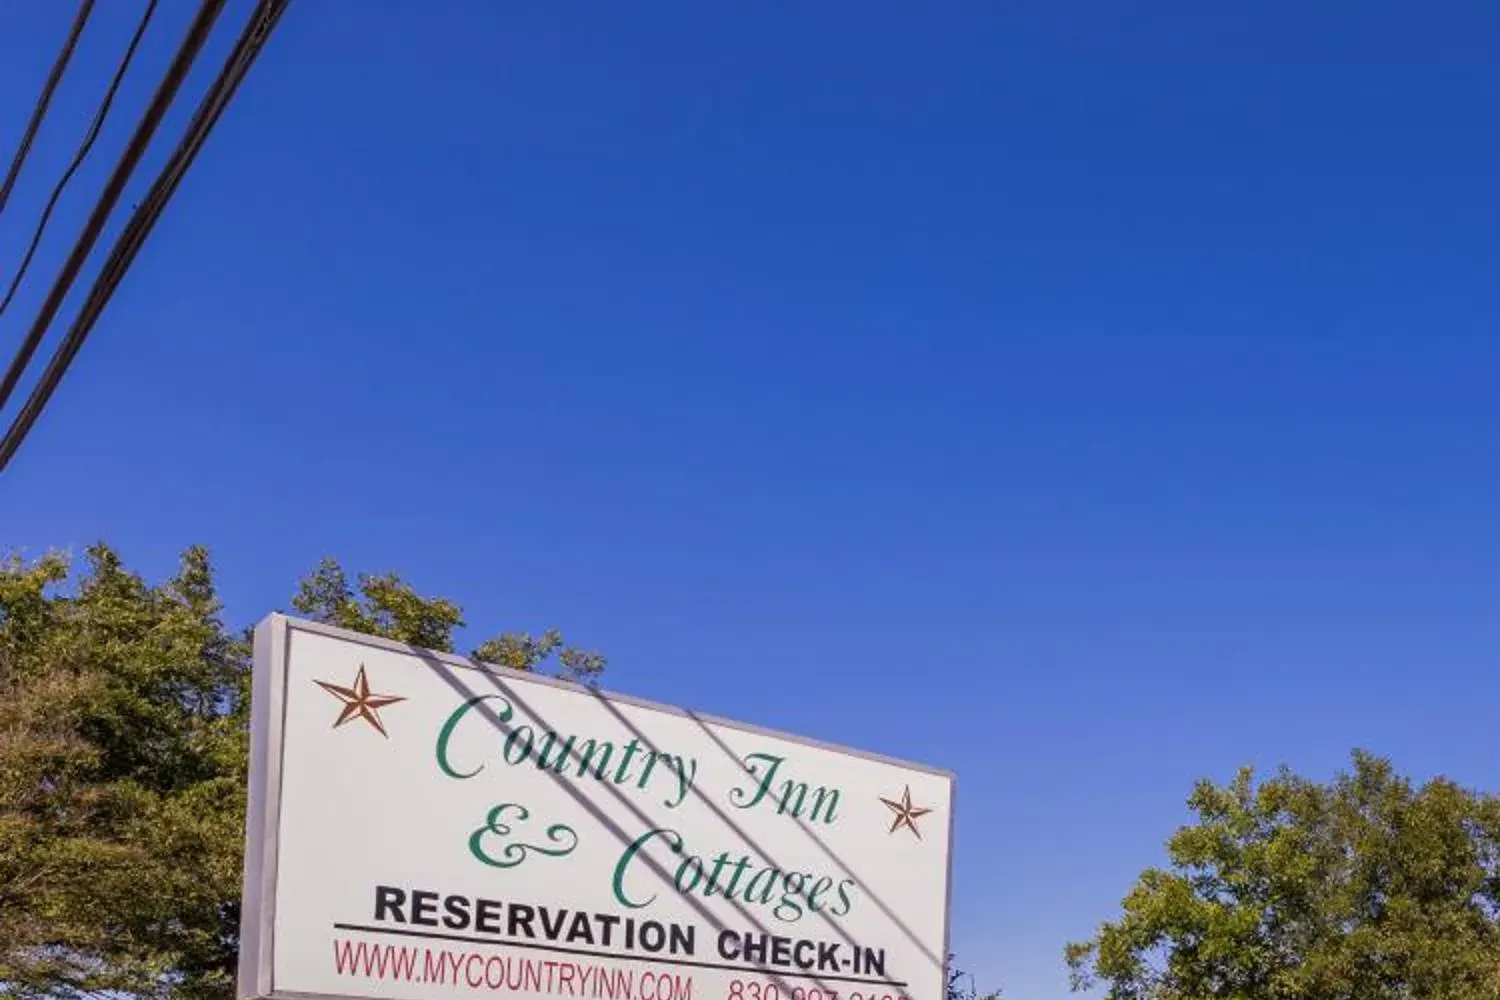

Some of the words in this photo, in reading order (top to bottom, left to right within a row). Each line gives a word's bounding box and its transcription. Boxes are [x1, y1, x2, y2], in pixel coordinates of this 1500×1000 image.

[435, 694, 697, 809] Country
[728, 752, 844, 825] Inn
[468, 803, 578, 868] &
[612, 829, 855, 922] Cottages
[374, 885, 695, 956] RESERVATION
[717, 930, 886, 976] CHECK-IN
